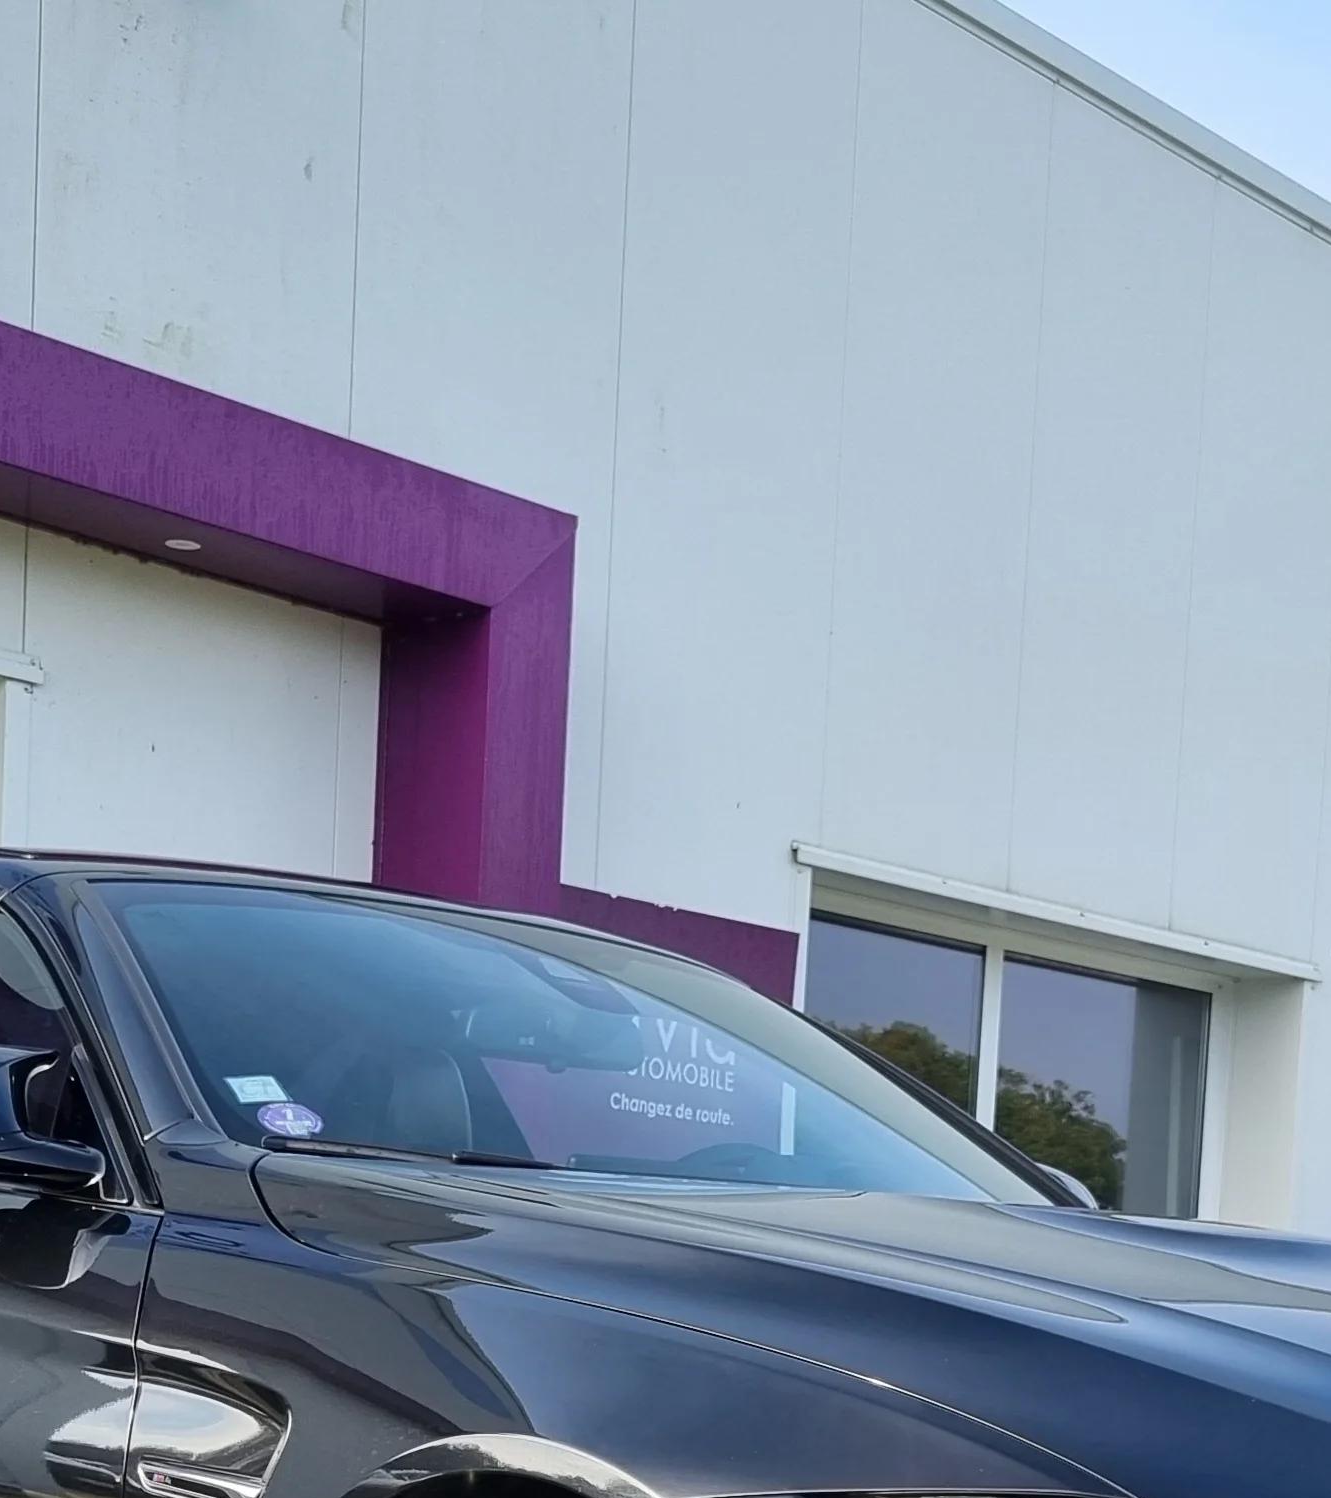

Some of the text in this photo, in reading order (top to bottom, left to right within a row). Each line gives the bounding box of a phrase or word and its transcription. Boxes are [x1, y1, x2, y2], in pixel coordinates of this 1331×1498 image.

[622, 1056, 734, 1092] TOMOBILE
[610, 1092, 734, 1126] Changez de route.
